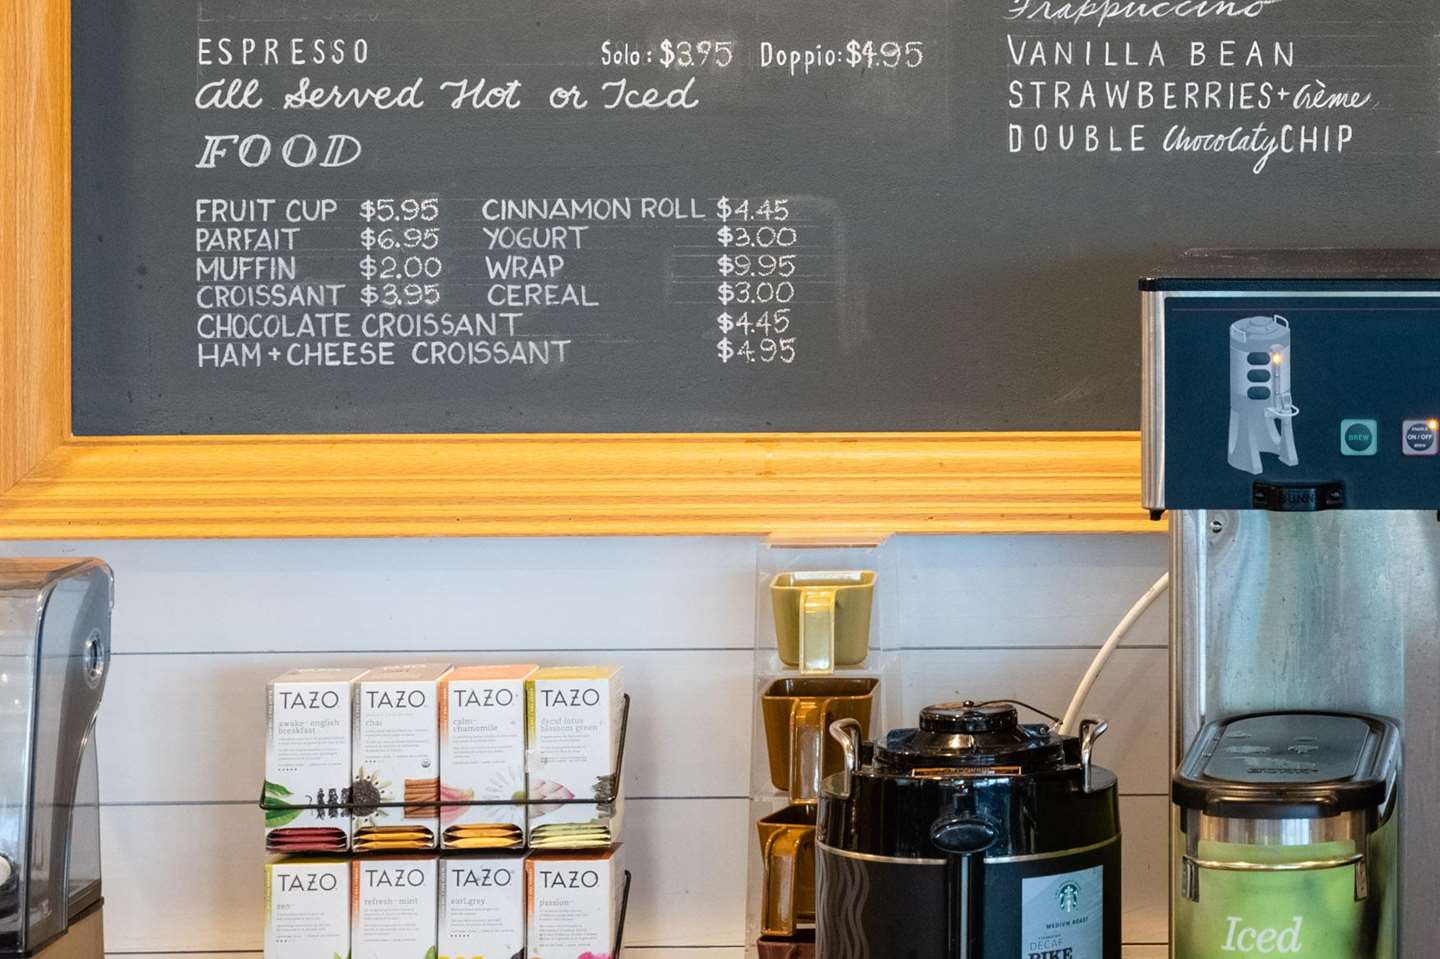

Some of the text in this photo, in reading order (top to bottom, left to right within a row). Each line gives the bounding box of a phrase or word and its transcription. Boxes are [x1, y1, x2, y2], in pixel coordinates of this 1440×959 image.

[199, 38, 367, 65] ESPRESSO
[1007, 34, 1293, 66] VANILLA BEAN
[283, 77, 699, 109] Served Hot or Iced
[195, 134, 361, 168] FOOD
[1009, 124, 1352, 153] DOUBLE CHIP
[196, 197, 705, 222] FRUIT CUP CINNAMON ROLL
[196, 226, 589, 252] PARFAIT YOGURT
[196, 255, 564, 281] MUFFIN WRAP
[197, 284, 599, 309] CROISSANT CEREAL
[197, 313, 523, 339] CHOCOLATE CROISSANT
[412, 340, 571, 364] CROISSANT
[280, 690, 339, 709] TAZO
[366, 690, 426, 709] TAZO
[453, 688, 513, 707] TAZO
[541, 688, 600, 707] TAZO
[277, 873, 337, 892] TAZO
[365, 868, 425, 887] TAZO
[452, 868, 511, 887] TAZO
[540, 870, 599, 889] TAZO
[1030, 938, 1063, 951] DECAF
[1221, 916, 1304, 953] Iced
